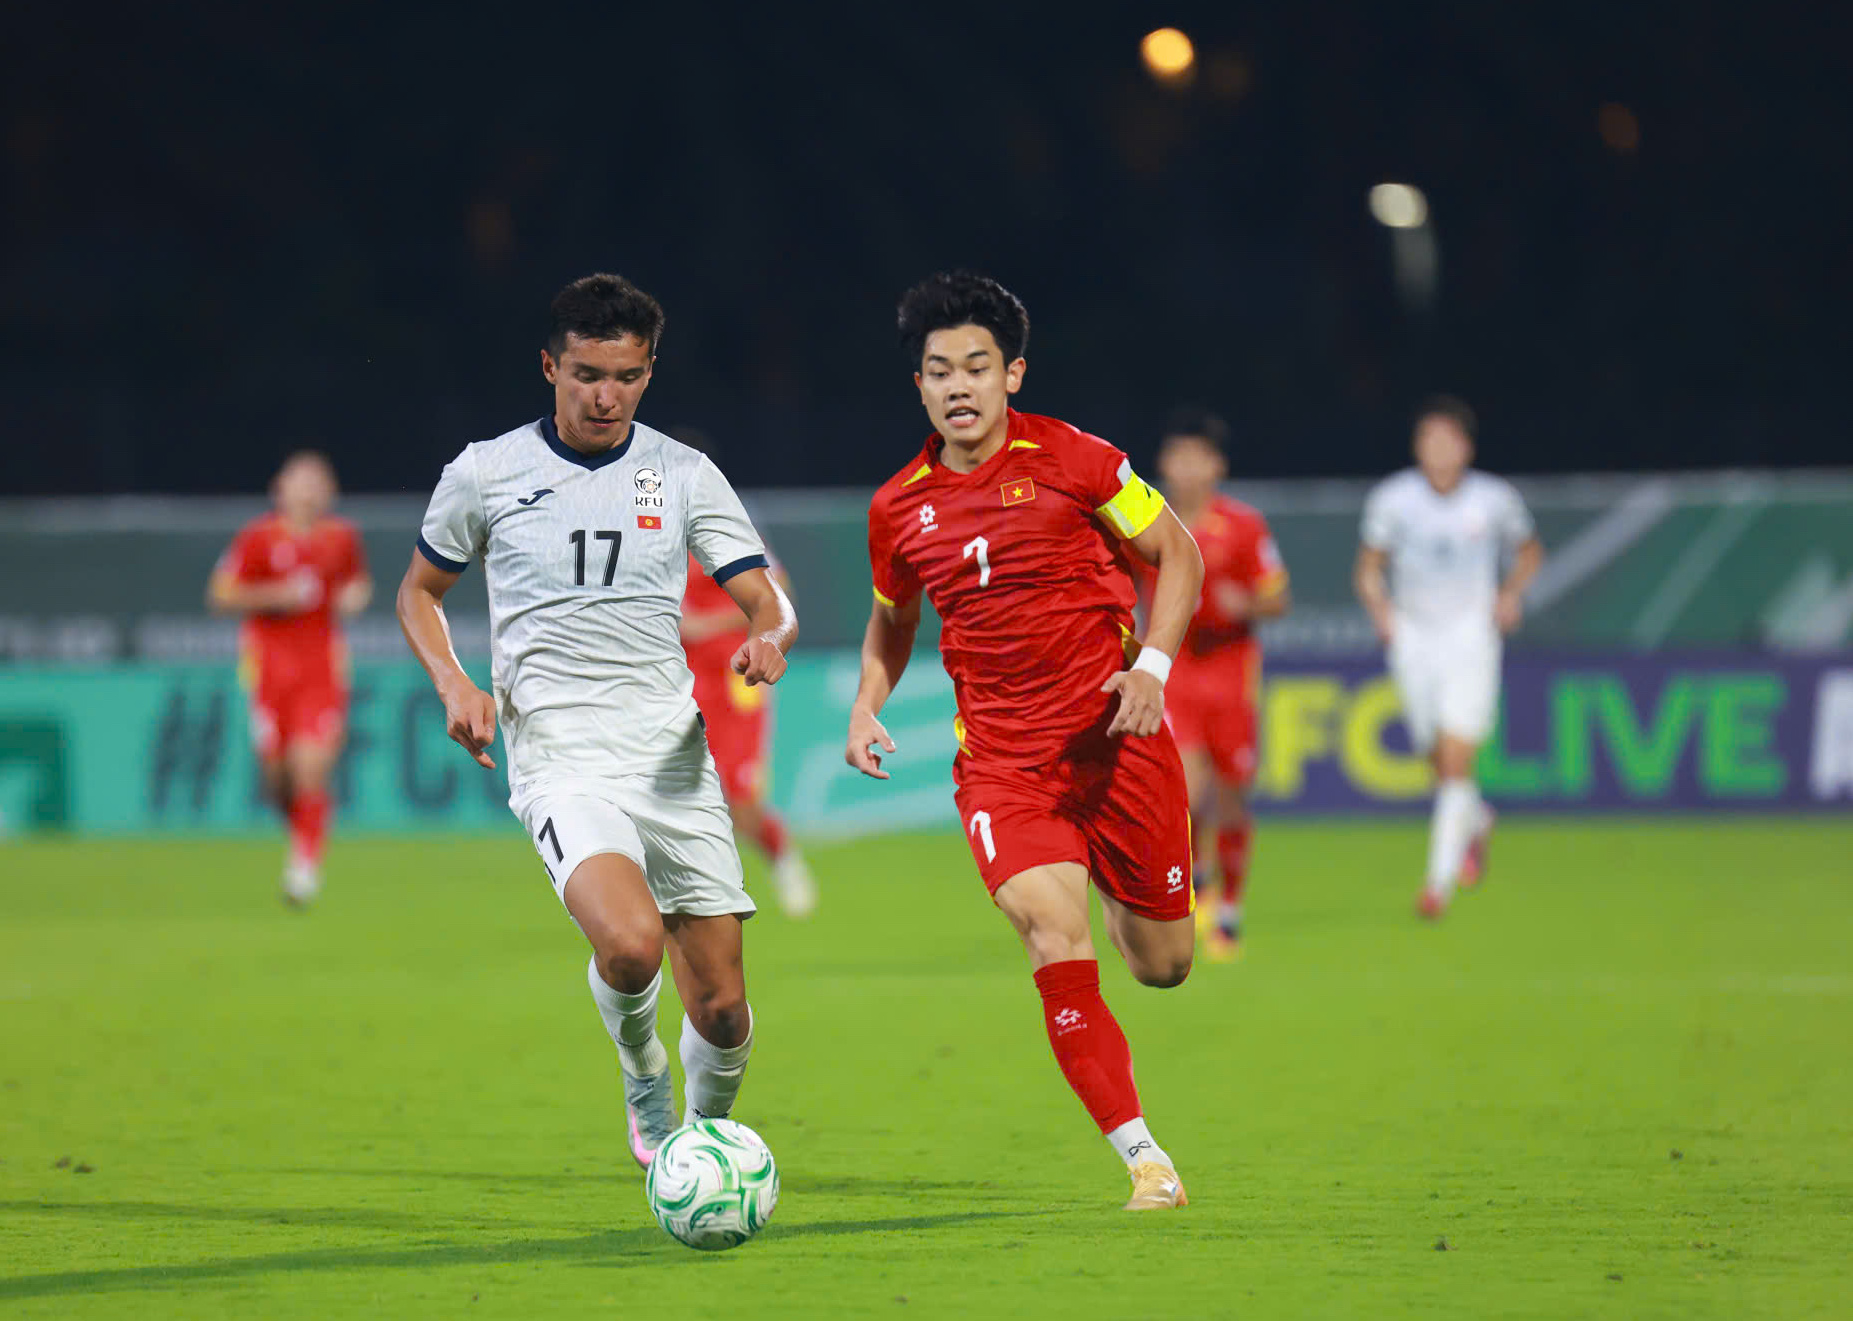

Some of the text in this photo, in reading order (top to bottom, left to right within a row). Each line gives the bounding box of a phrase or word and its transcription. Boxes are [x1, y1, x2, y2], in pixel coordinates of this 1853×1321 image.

[635, 496, 663, 508] KFU
[569, 529, 623, 587] 17
[1260, 676, 1434, 800] FC
